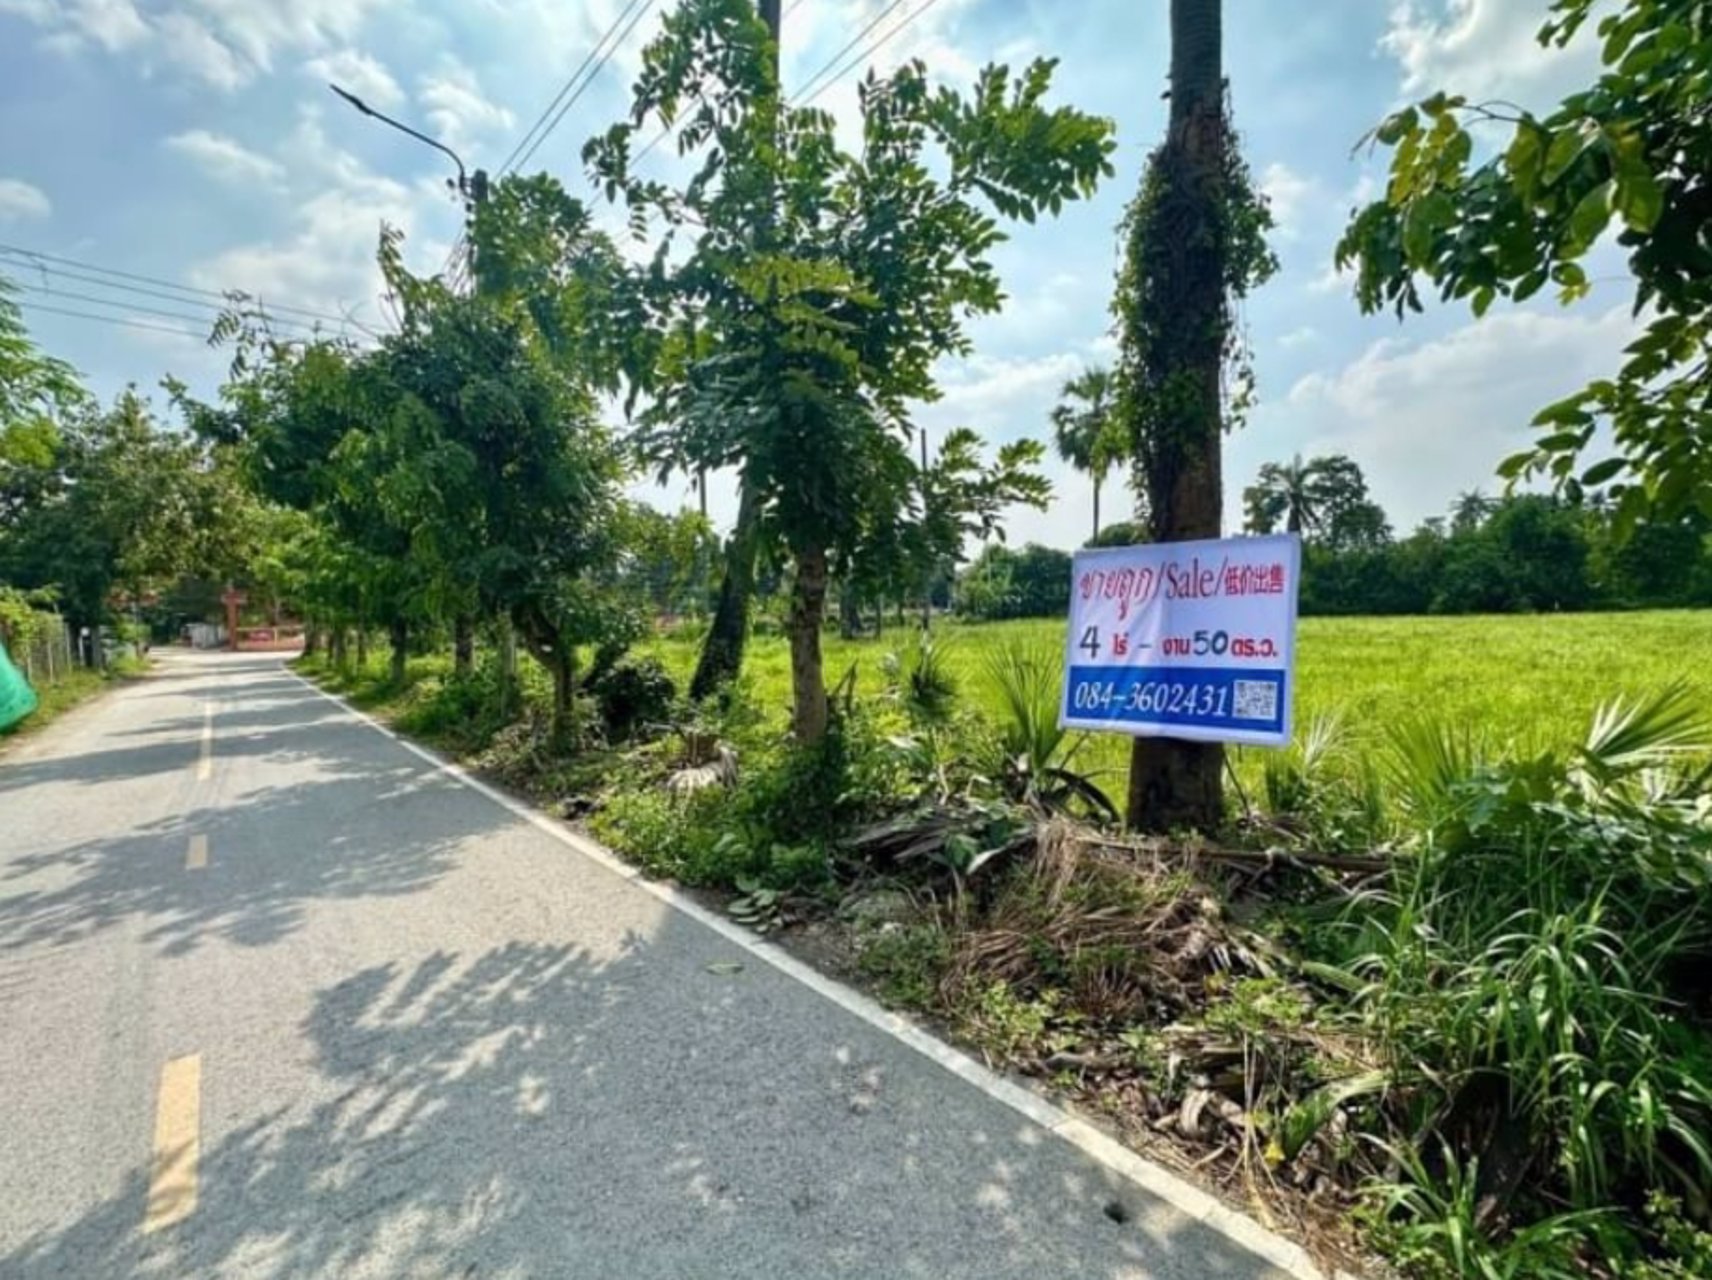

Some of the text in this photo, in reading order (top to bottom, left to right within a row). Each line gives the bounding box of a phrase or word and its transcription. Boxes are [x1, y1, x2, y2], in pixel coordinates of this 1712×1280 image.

[1080, 625, 1100, 659] 4
[1113, 632, 1129, 655] ไร่
[1163, 638, 1190, 656] งาน
[1193, 630, 1229, 656] 50
[1075, 680, 1228, 717] 084-3602431
